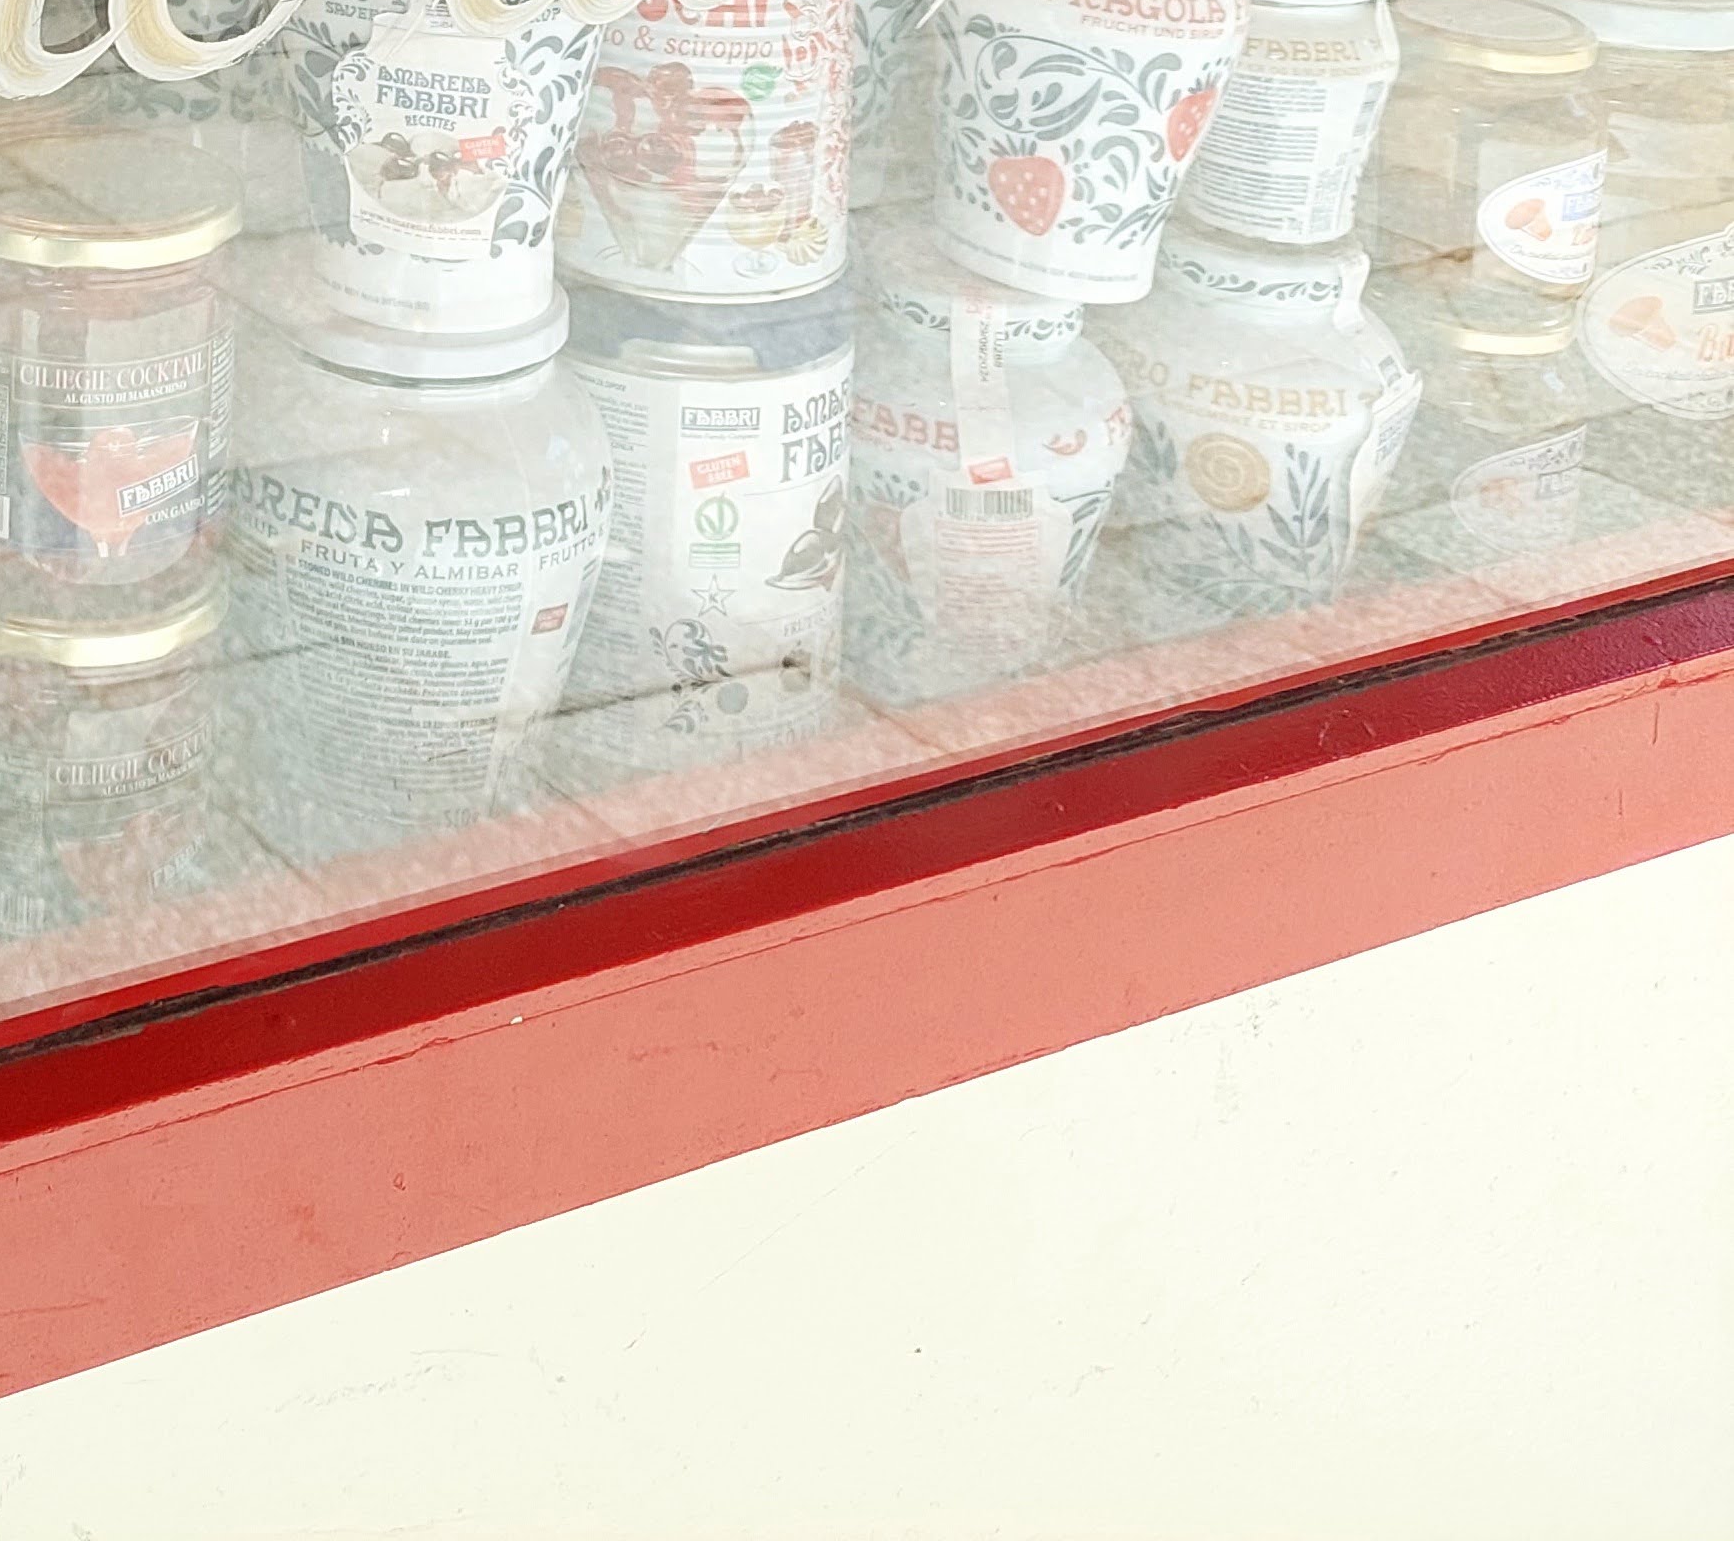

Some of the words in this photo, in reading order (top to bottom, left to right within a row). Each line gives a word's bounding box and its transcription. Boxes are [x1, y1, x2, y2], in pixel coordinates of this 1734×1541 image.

[1080, 14, 1149, 37] FRUCHT
[1153, 25, 1184, 40] UND
[663, 33, 774, 65] sciroppo
[1241, 37, 1362, 63] FABBRI
[375, 83, 491, 119] FABBRI
[404, 114, 457, 133] RECETTES
[19, 363, 109, 393] CILIEGIE
[116, 351, 206, 389] COCKTAIL
[64, 393, 79, 404] AL
[80, 393, 114, 405] GUSTO
[127, 380, 188, 402] MARASCHINO
[1185, 372, 1349, 418] FABBRI
[683, 408, 761, 428] FABBRI
[122, 460, 197, 509] FABBRI
[144, 508, 169, 526] CON
[422, 501, 590, 558] FABBRI
[299, 538, 380, 574] FRUTA
[390, 560, 406, 577] Y
[413, 561, 521, 582] ALMIBAR
[537, 529, 597, 572] FRUTTO
